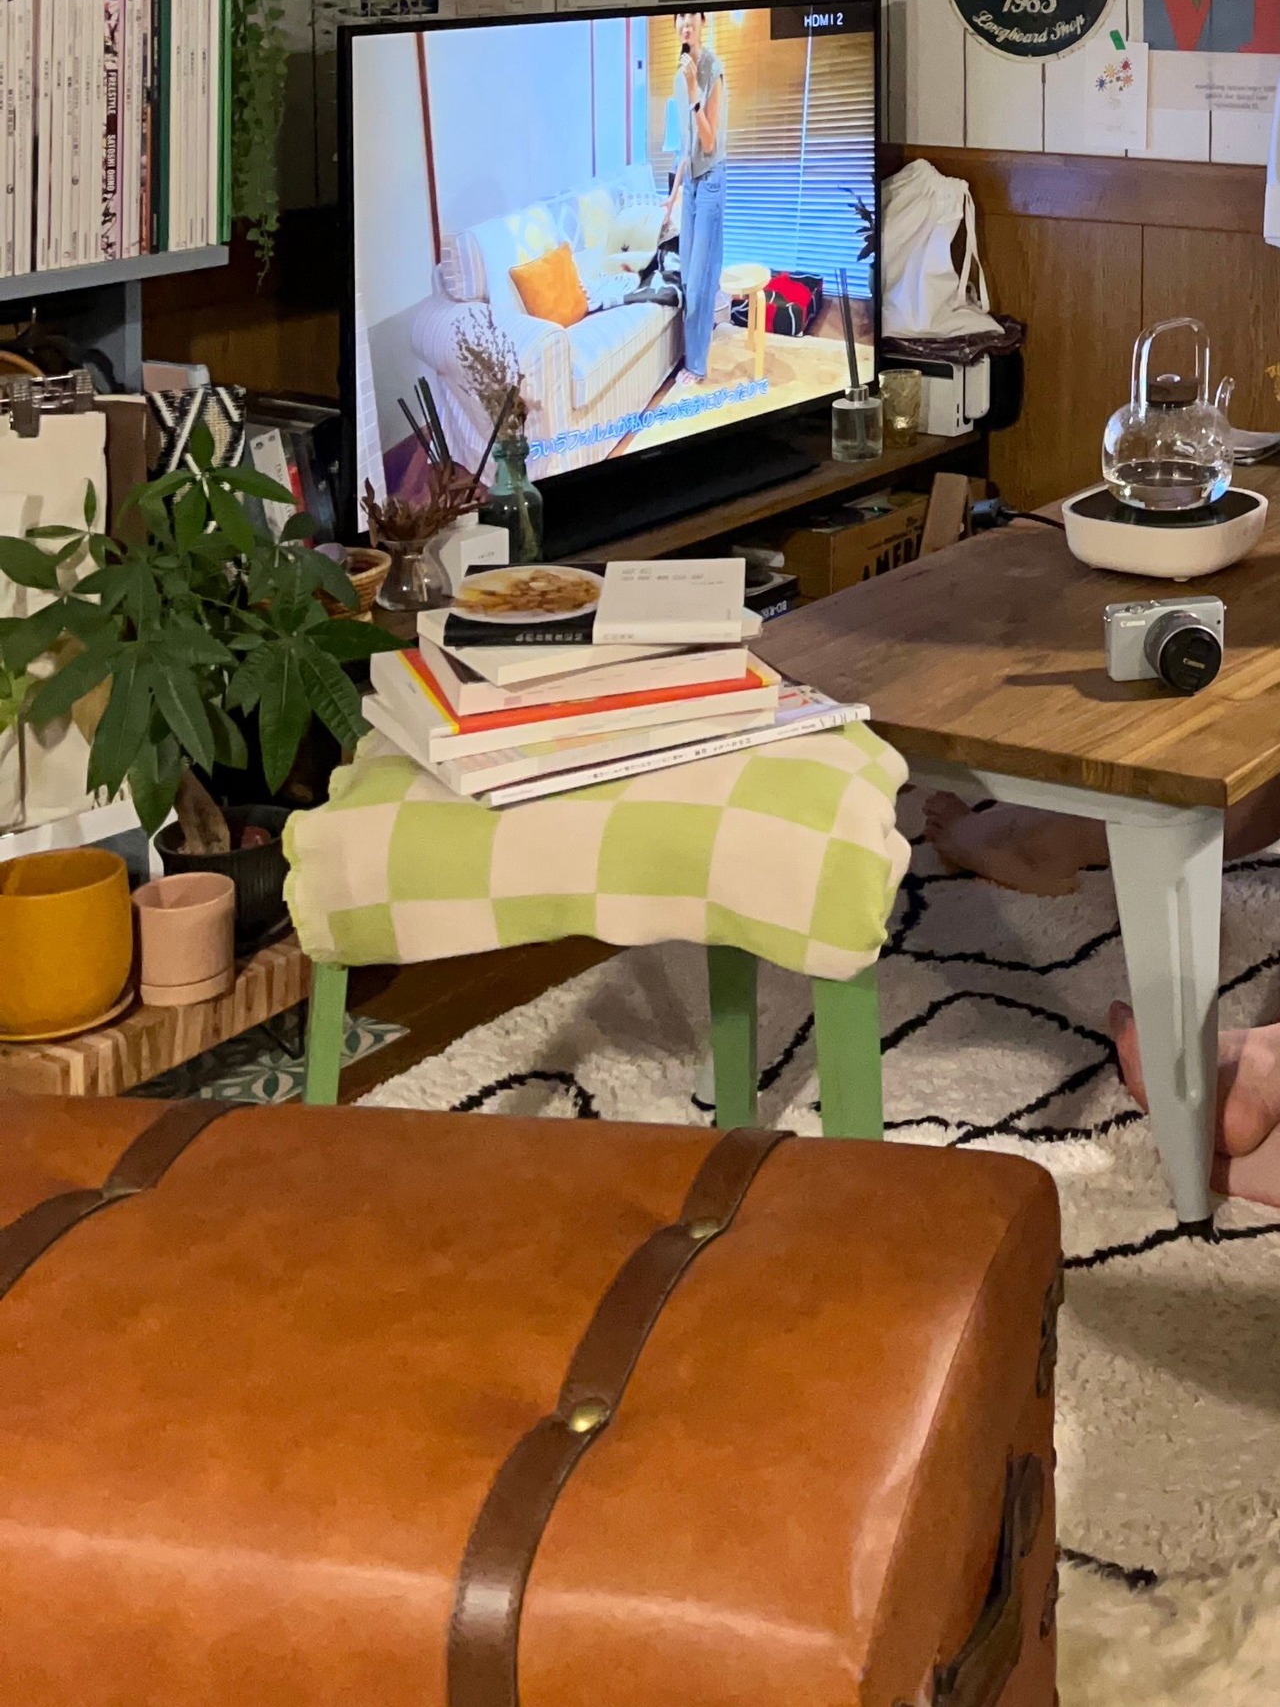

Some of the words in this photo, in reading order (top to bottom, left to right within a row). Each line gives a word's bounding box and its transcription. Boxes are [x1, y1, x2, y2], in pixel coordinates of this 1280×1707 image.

[803, 13, 834, 28] HDMI
[836, 12, 844, 25] 2
[972, 10, 1048, 44] Longboard
[1050, 14, 1086, 40] Shop
[107, 71, 117, 115] FREESTYLE
[107, 134, 116, 168] SATOSHI
[107, 169, 116, 192] OHNO
[527, 378, 769, 462] ういうフォルムが私の今の気分にぴったりで
